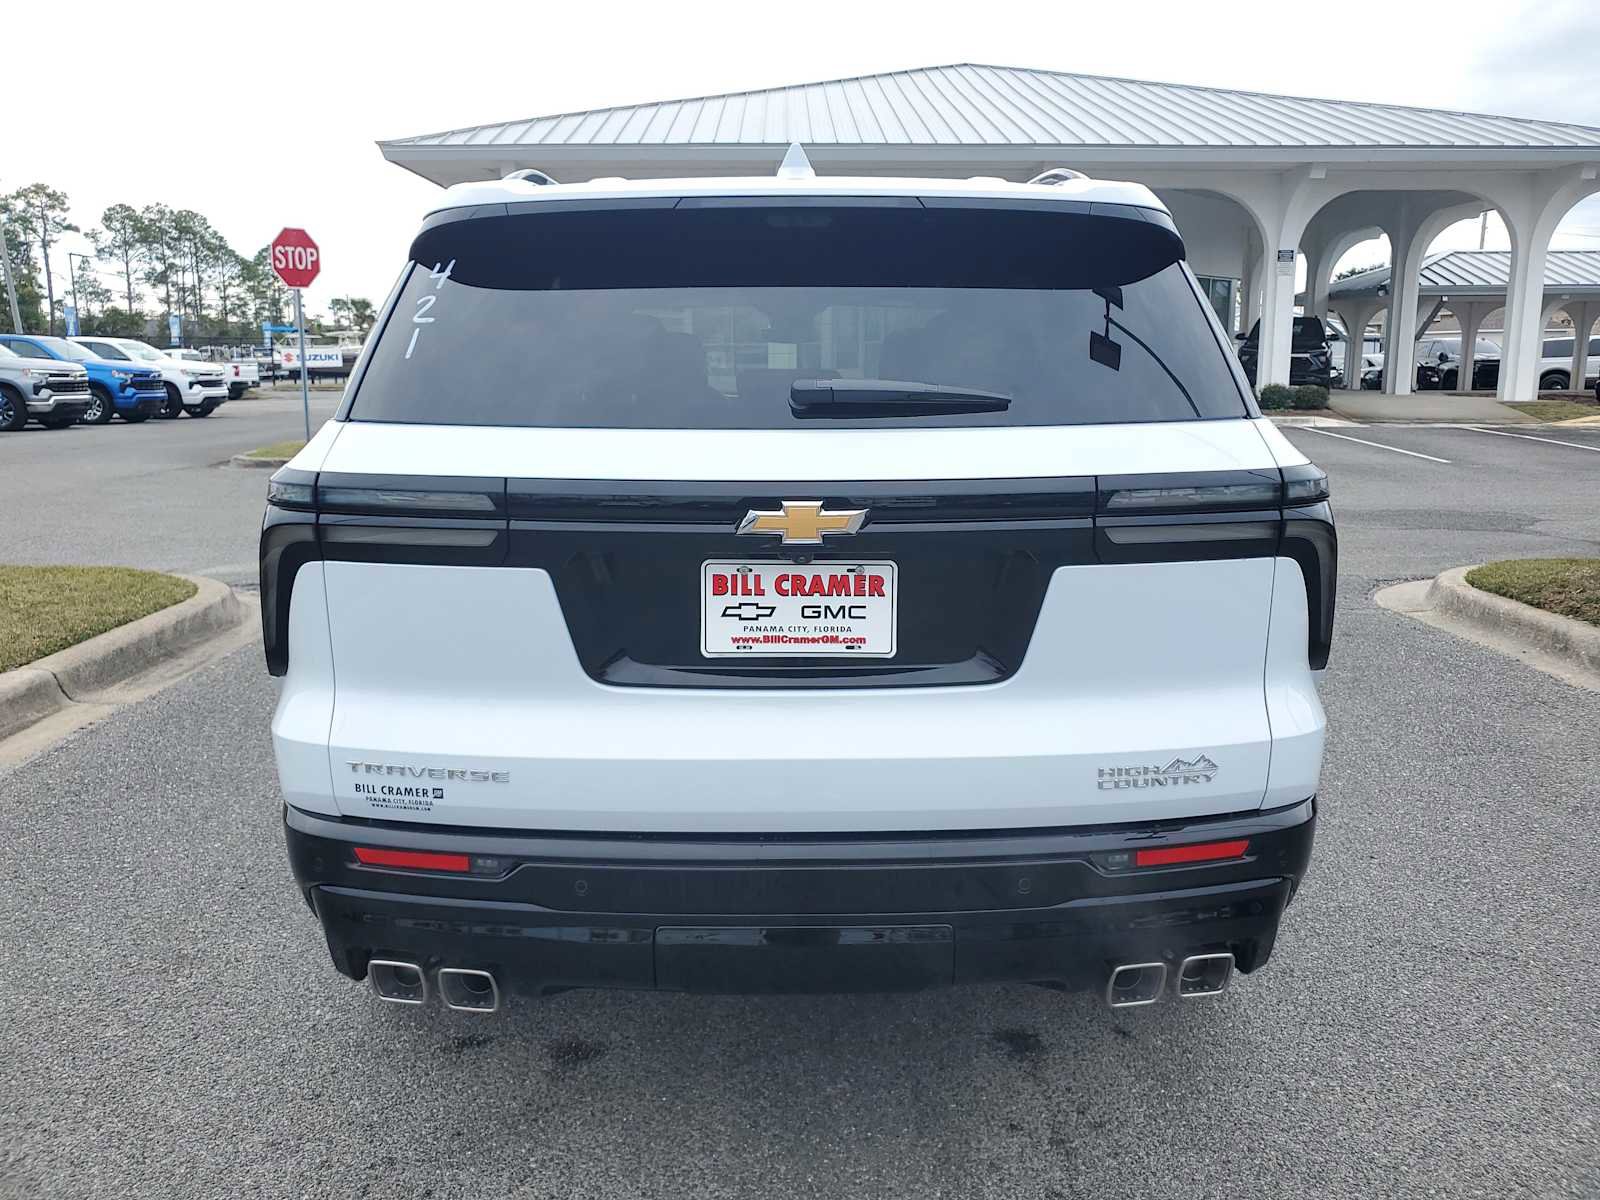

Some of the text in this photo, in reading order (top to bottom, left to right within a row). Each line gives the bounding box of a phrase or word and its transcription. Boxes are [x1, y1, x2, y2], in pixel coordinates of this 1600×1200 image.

[275, 245, 317, 270] STOP
[712, 573, 886, 597] BILL CRAMER
[801, 605, 866, 619] GMC
[788, 625, 809, 633] CITY,
[731, 635, 866, 644] www.BillCramerGM.com
[346, 761, 510, 783] TRAVERSE
[1097, 766, 1161, 777] HIGH
[1097, 773, 1217, 790] COUNTRY
[355, 783, 376, 794] BILL
[381, 785, 429, 798] CRAMER
